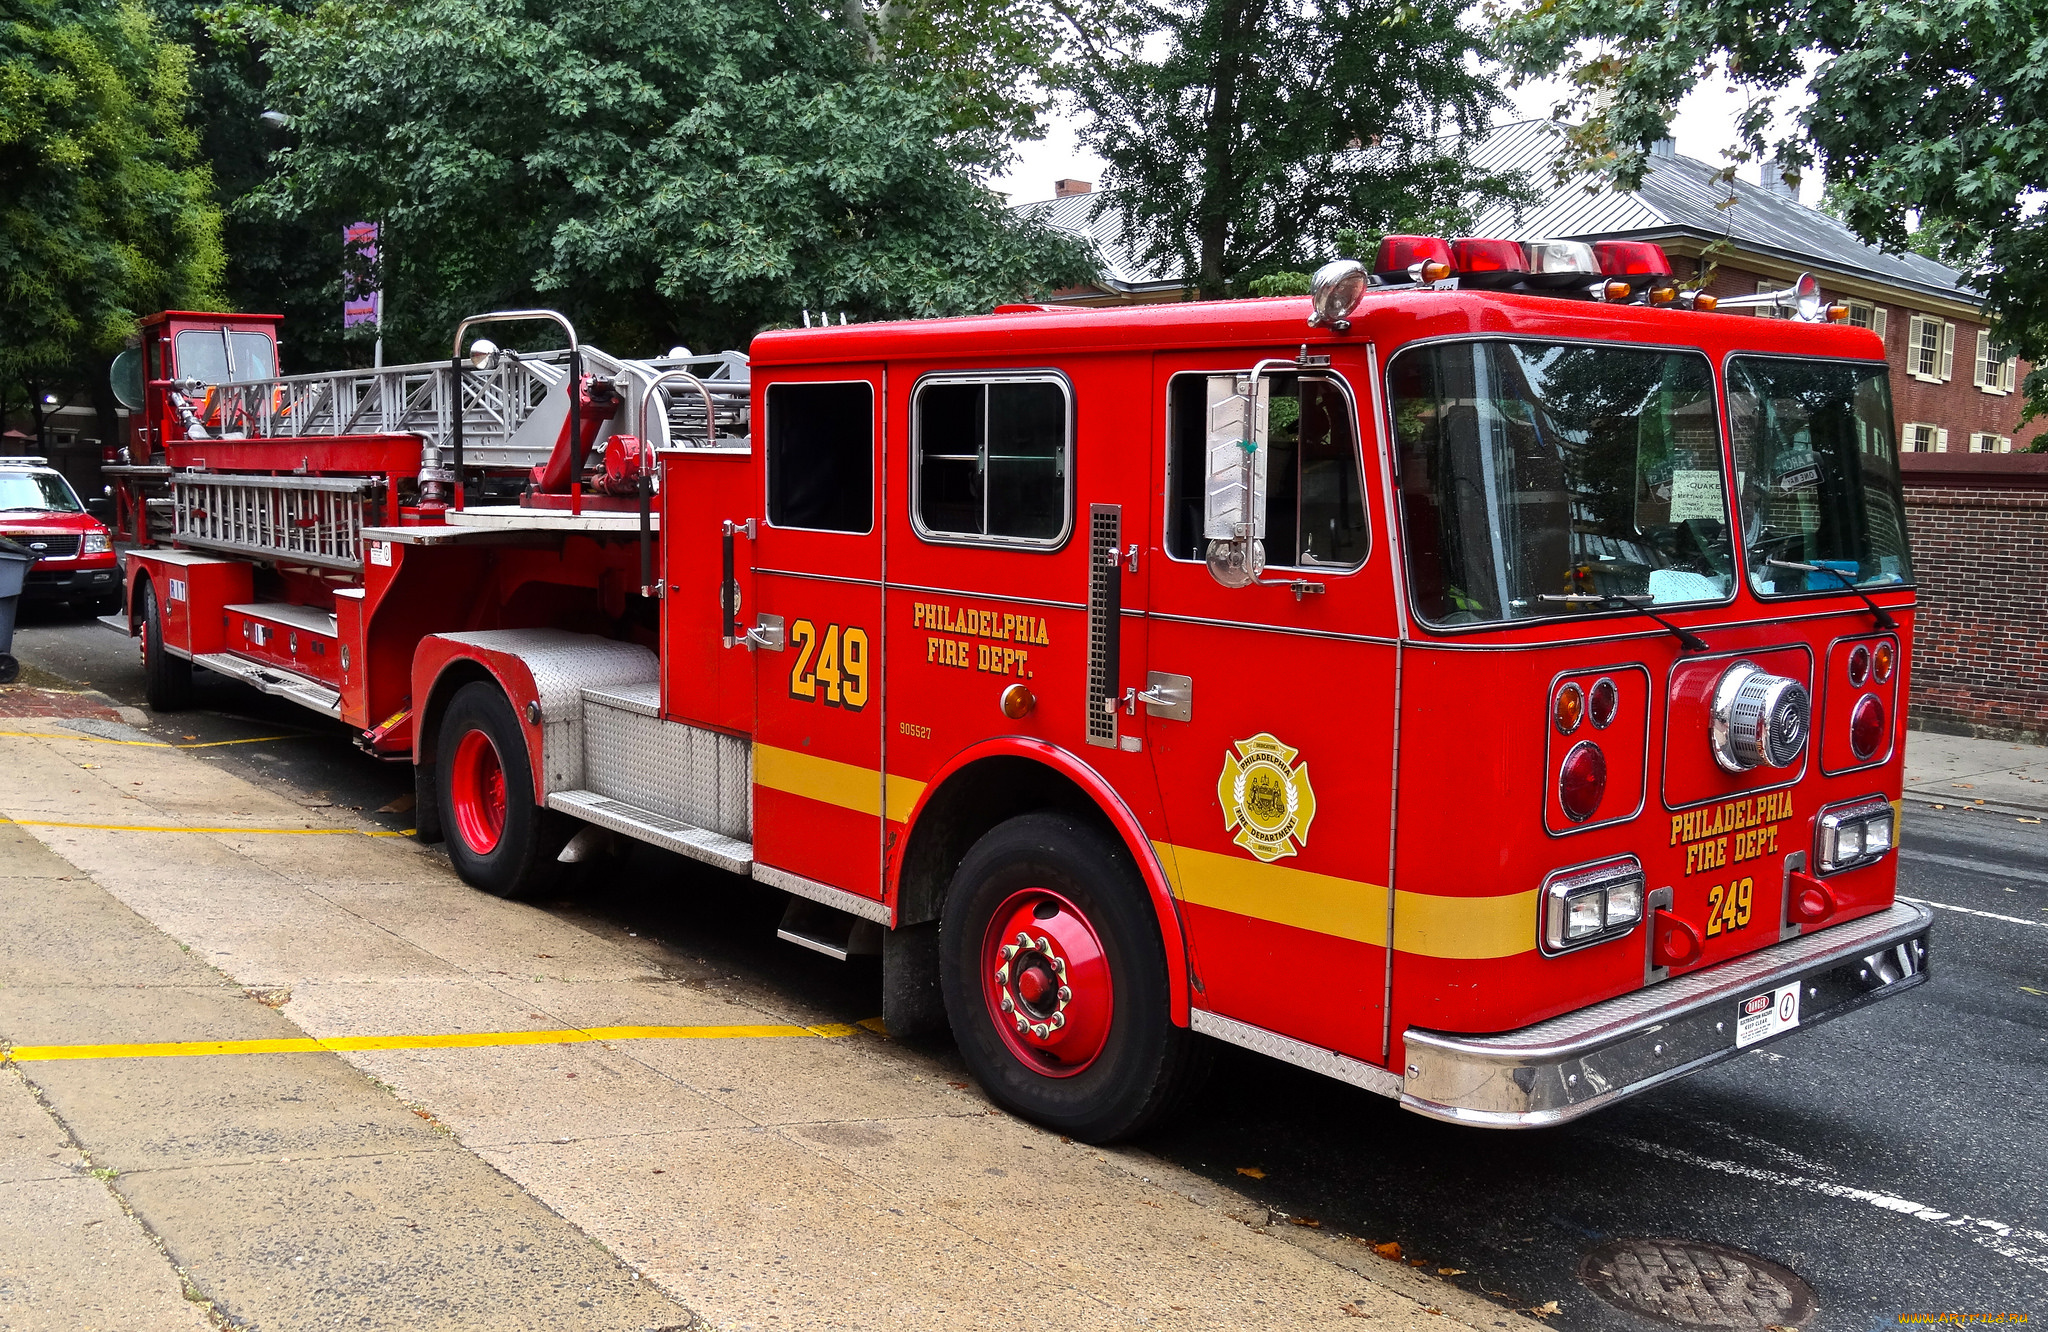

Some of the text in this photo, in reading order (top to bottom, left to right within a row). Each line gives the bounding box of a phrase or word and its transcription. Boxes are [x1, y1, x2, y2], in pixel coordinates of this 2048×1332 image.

[1689, 482, 1721, 491] QUAKE
[914, 603, 1049, 645] PHILADELPHIA
[789, 618, 868, 712] 249
[927, 638, 1033, 679] FIRE DEPT.
[899, 721, 931, 740] 905527
[1240, 754, 1290, 777] PHILADELPHIA
[1236, 809, 1295, 842] FIRE DEPARTMENT
[1670, 791, 1793, 847] PHILADELPHIA
[1685, 825, 1778, 876] FIRE DEPT.
[1706, 877, 1753, 939] 249
